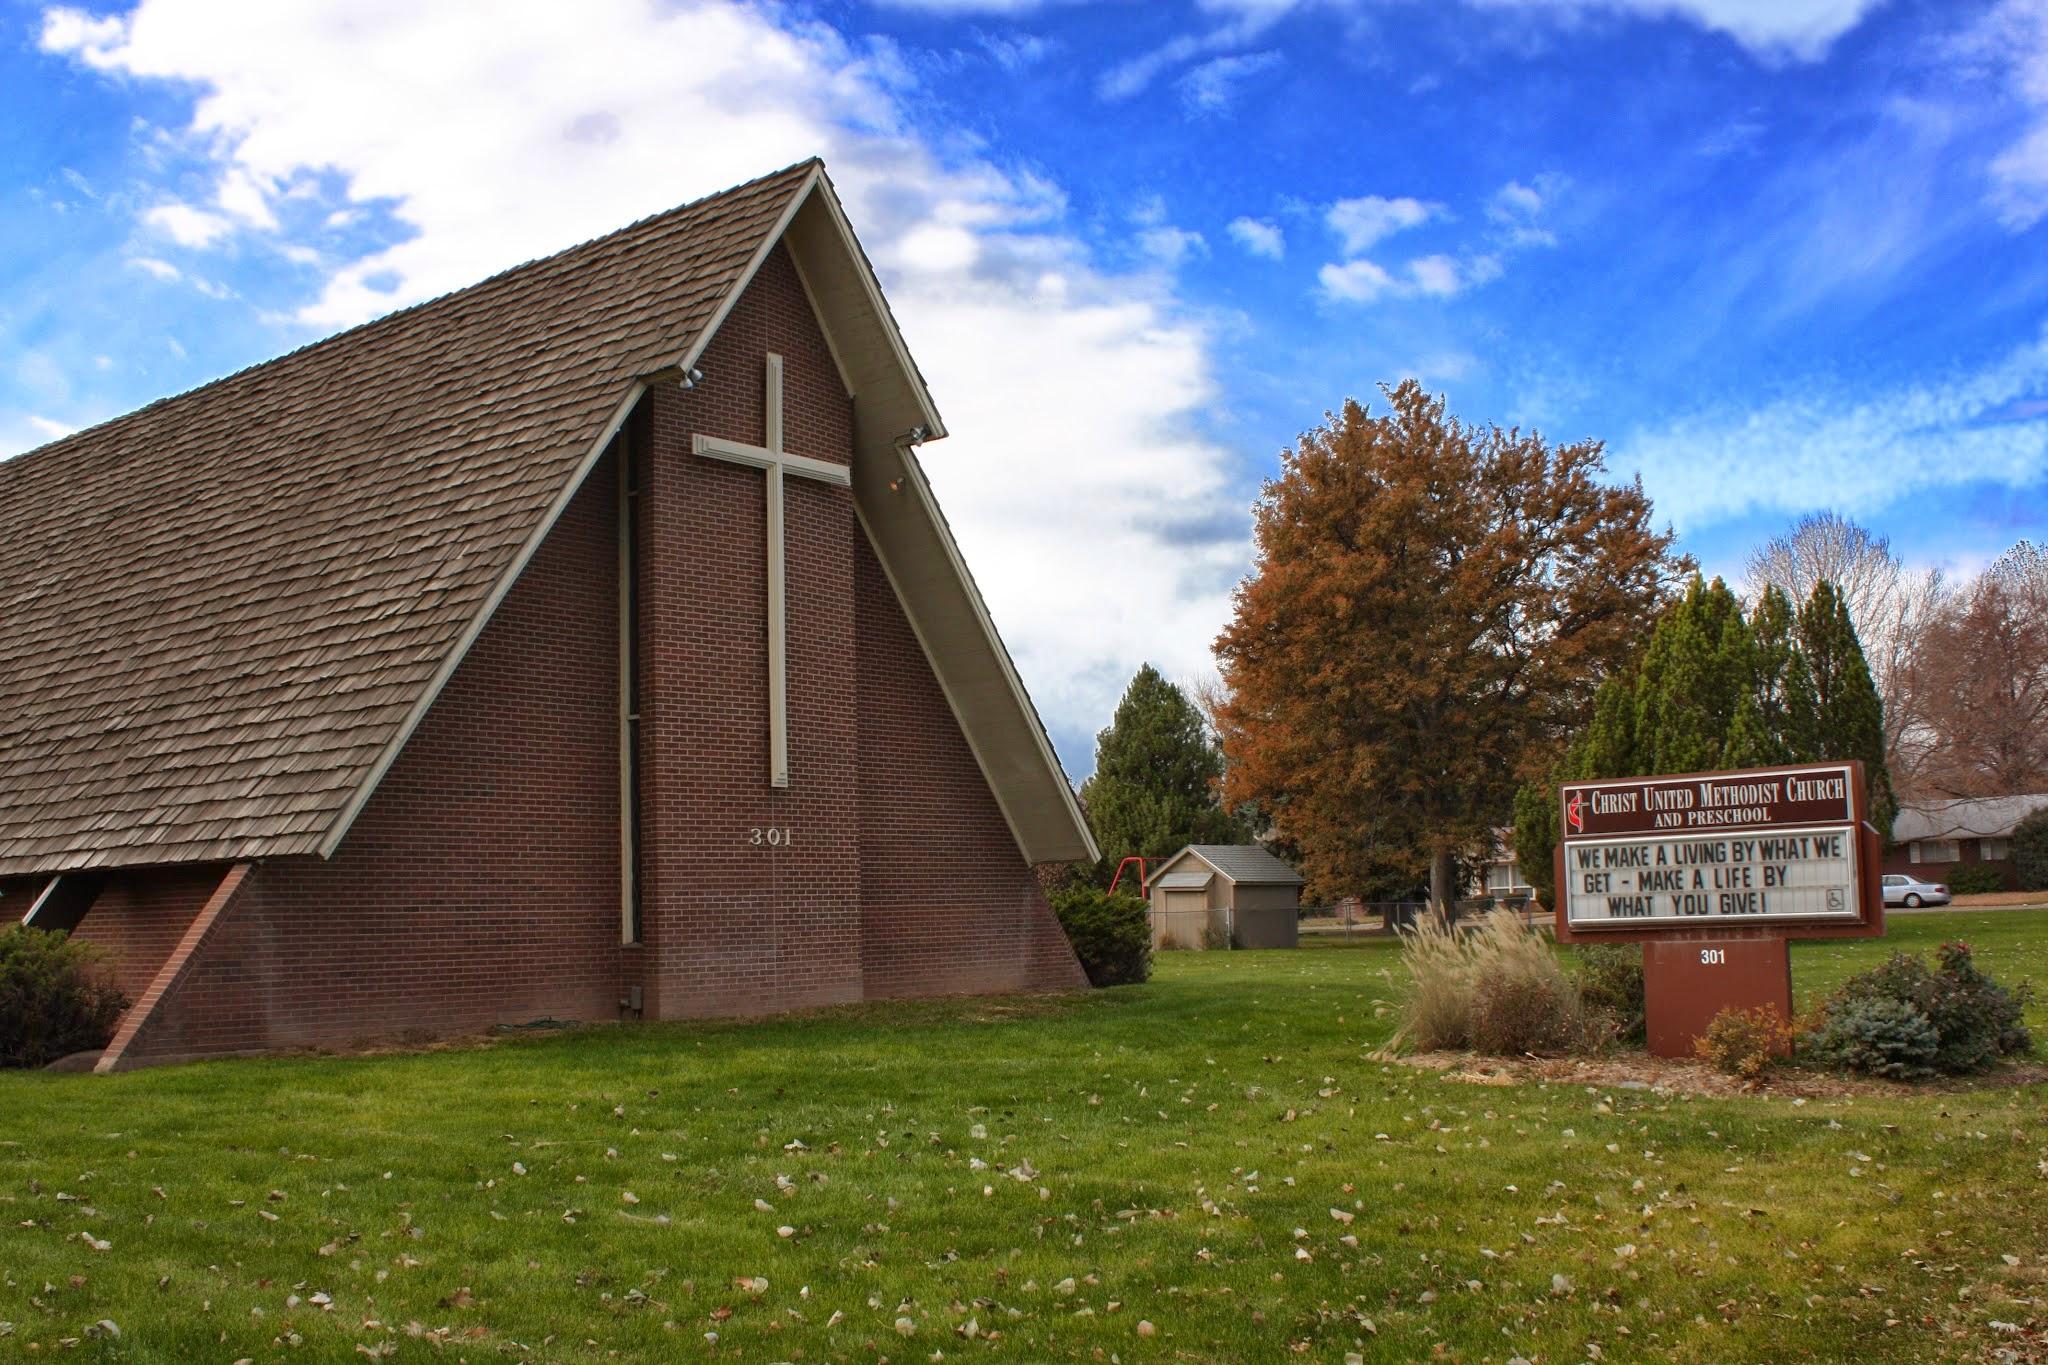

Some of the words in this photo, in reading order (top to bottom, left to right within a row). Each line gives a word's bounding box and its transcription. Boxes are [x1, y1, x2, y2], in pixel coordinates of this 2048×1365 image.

[1591, 790, 1637, 814] CHRIST
[1644, 787, 1693, 811] UNITED
[1700, 783, 1779, 807] METHODIST
[1786, 777, 1844, 802] CHURCH
[1654, 812, 1681, 827] AND
[1688, 807, 1771, 826] PRESCHOOL
[751, 828, 791, 846] 301
[1578, 848, 1600, 869] WE
[1605, 846, 1649, 868] MAKE
[1656, 845, 1666, 866] A
[1674, 842, 1726, 865] LIVING
[1732, 841, 1755, 862] BY
[1759, 838, 1809, 860] WHAT
[1815, 836, 1840, 857] WE
[1584, 873, 1611, 893] GET
[1638, 870, 1684, 891] MAKE
[1693, 869, 1703, 889] A
[1714, 867, 1751, 888] LIFE
[1764, 866, 1787, 887] BY
[1608, 896, 1653, 917] WHAT
[1672, 895, 1707, 915] YOU
[1701, 949, 1725, 964] 301
